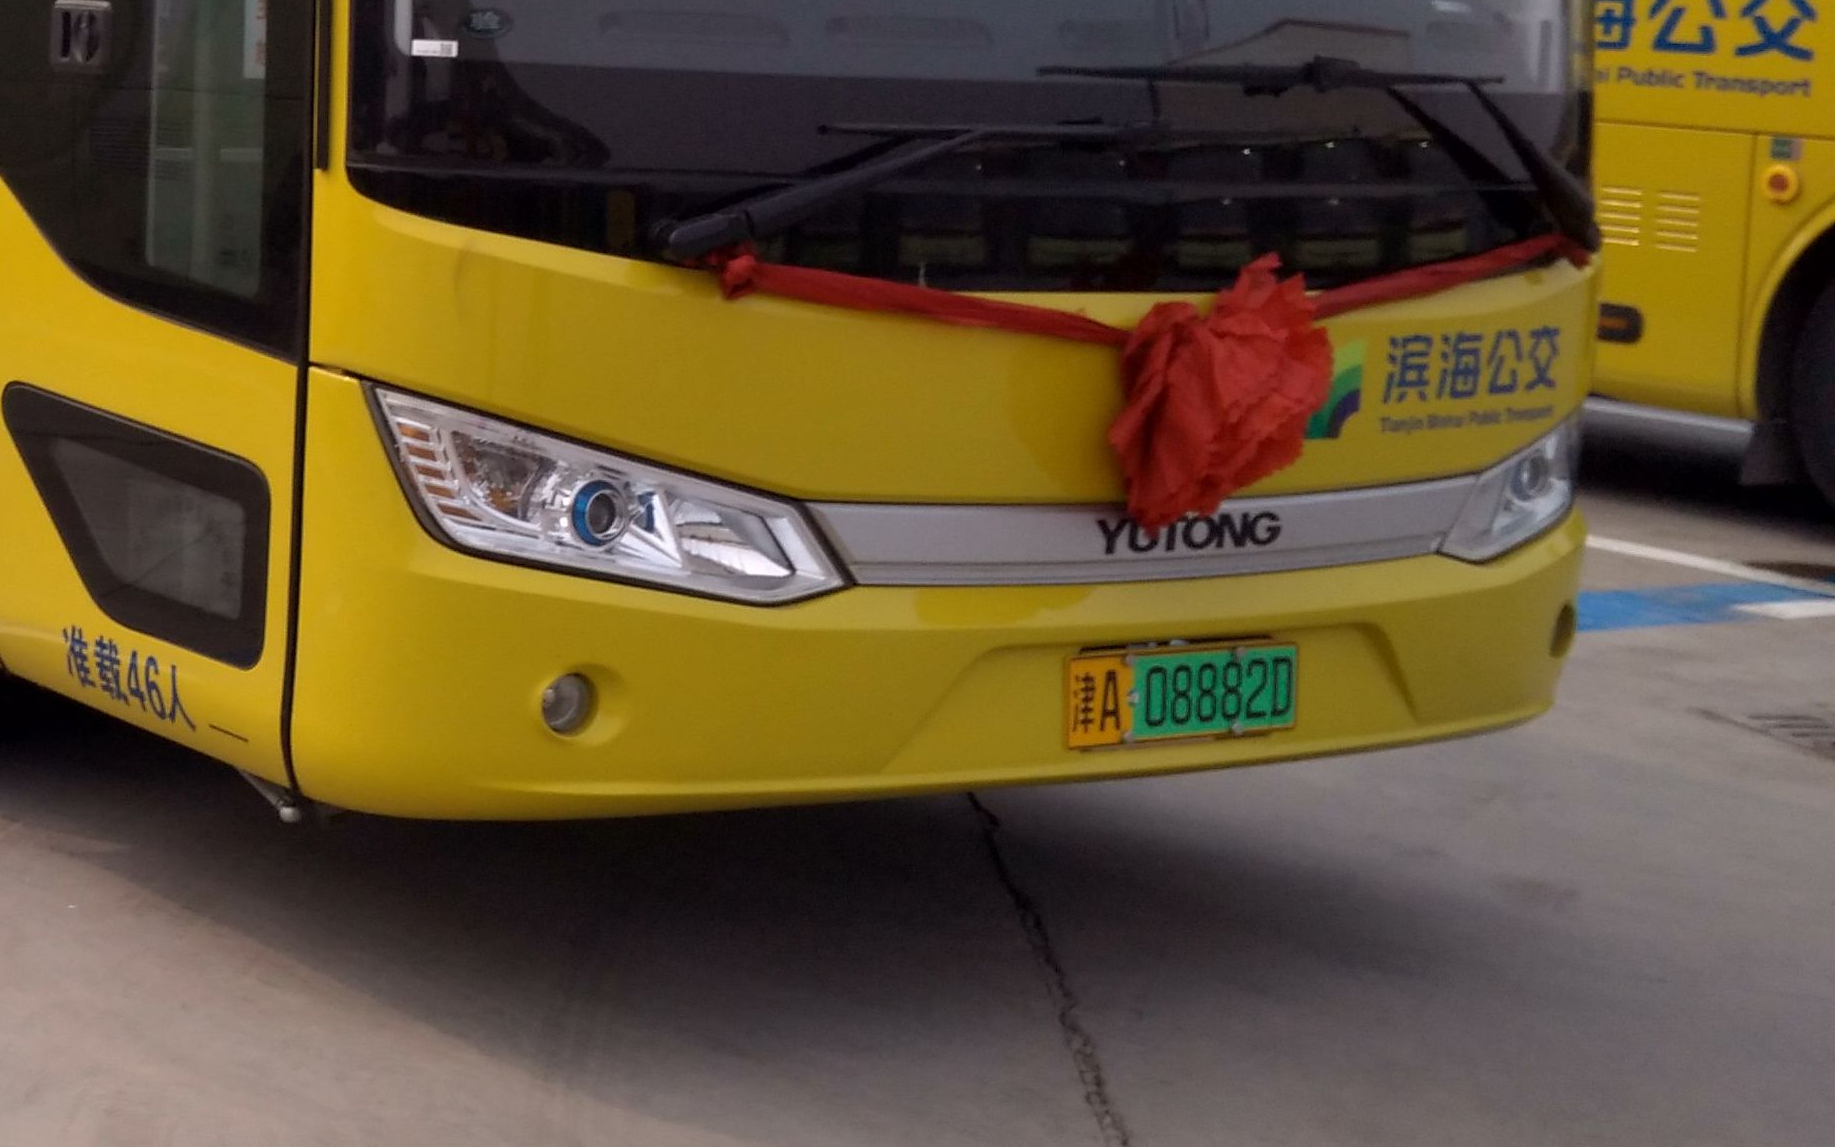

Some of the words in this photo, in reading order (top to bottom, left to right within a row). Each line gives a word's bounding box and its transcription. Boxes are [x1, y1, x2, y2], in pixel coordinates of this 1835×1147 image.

[1617, 66, 1685, 89] Public
[1693, 69, 1812, 98] Transport
[1382, 326, 1560, 403] 滨海公交
[63, 625, 196, 731] 准载46人
